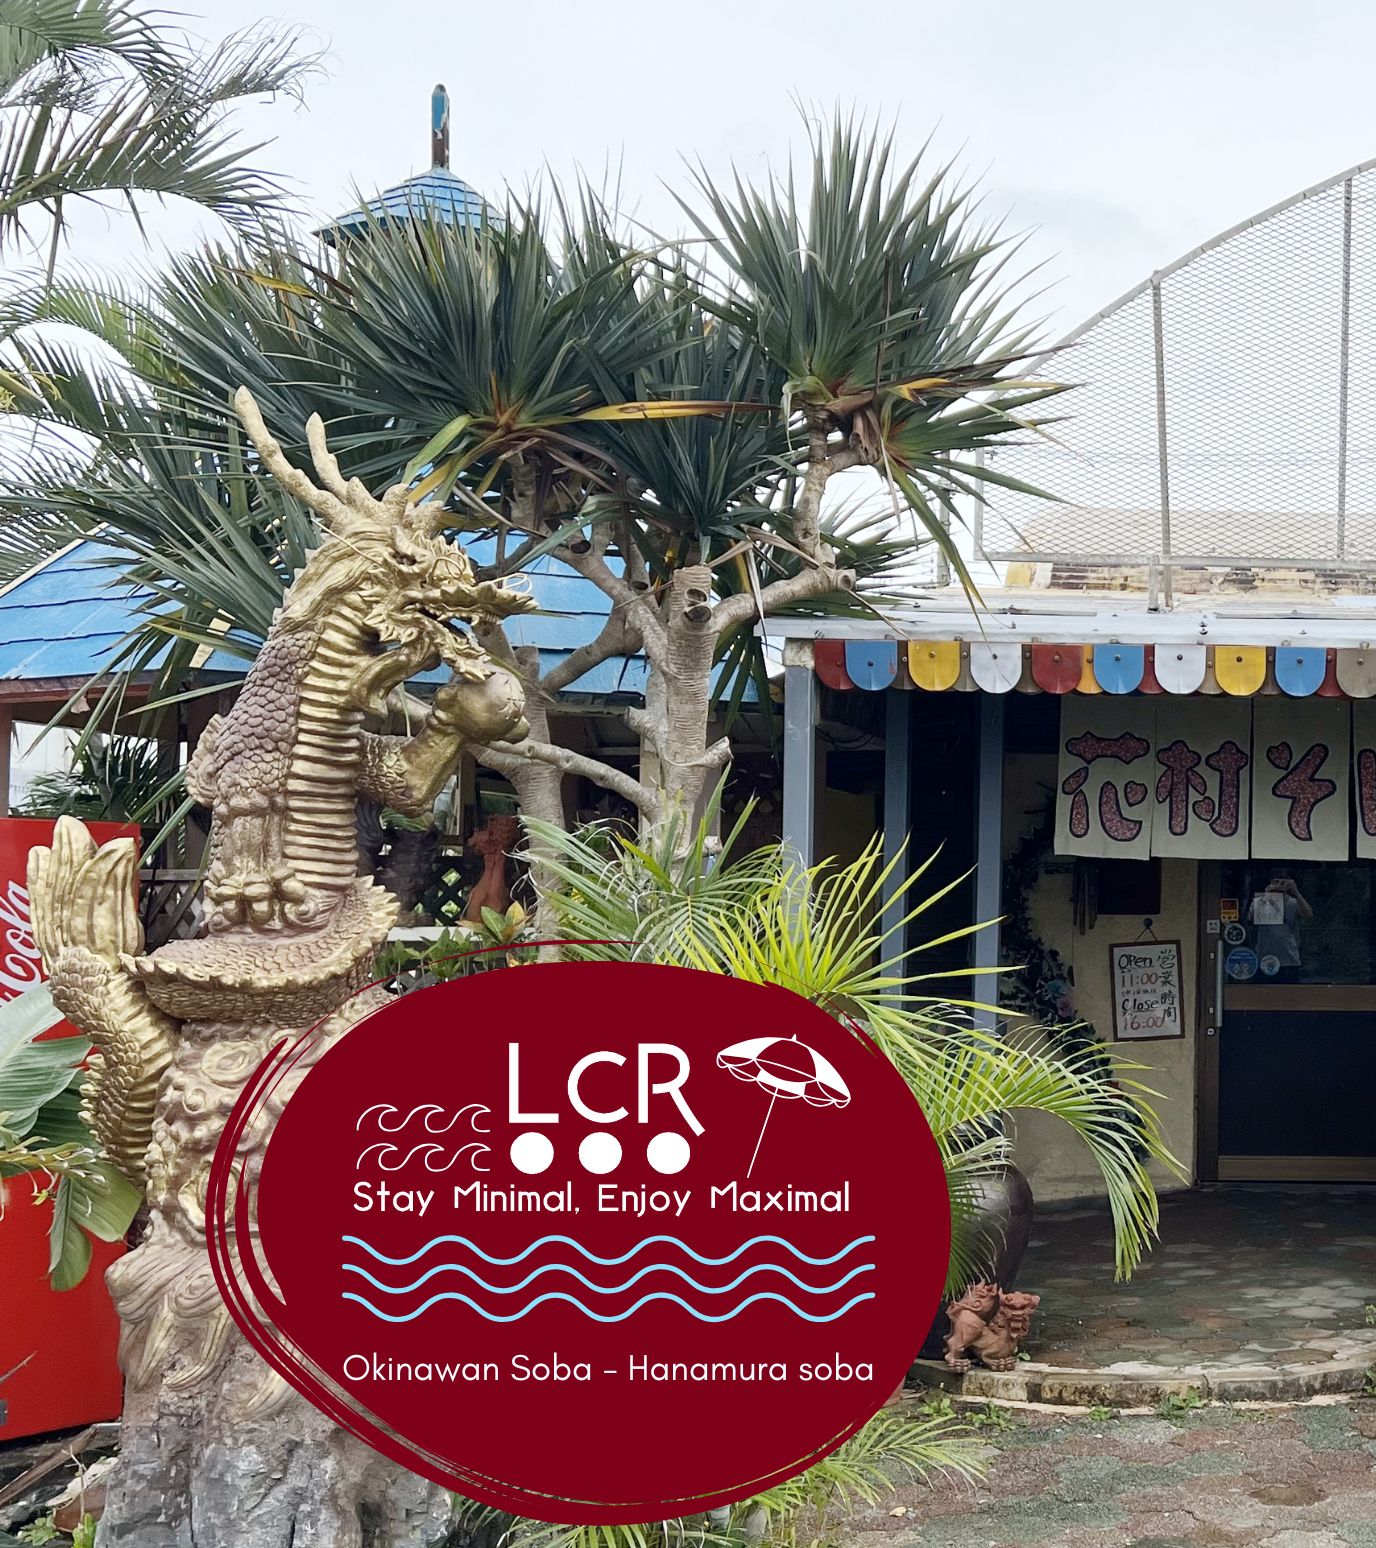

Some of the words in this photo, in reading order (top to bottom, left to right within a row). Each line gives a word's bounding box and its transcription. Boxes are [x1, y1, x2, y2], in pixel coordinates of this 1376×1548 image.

[1121, 972, 1158, 988] 11:00
[1121, 998, 1160, 1012] Close
[1124, 1010, 1167, 1031] 16:00
